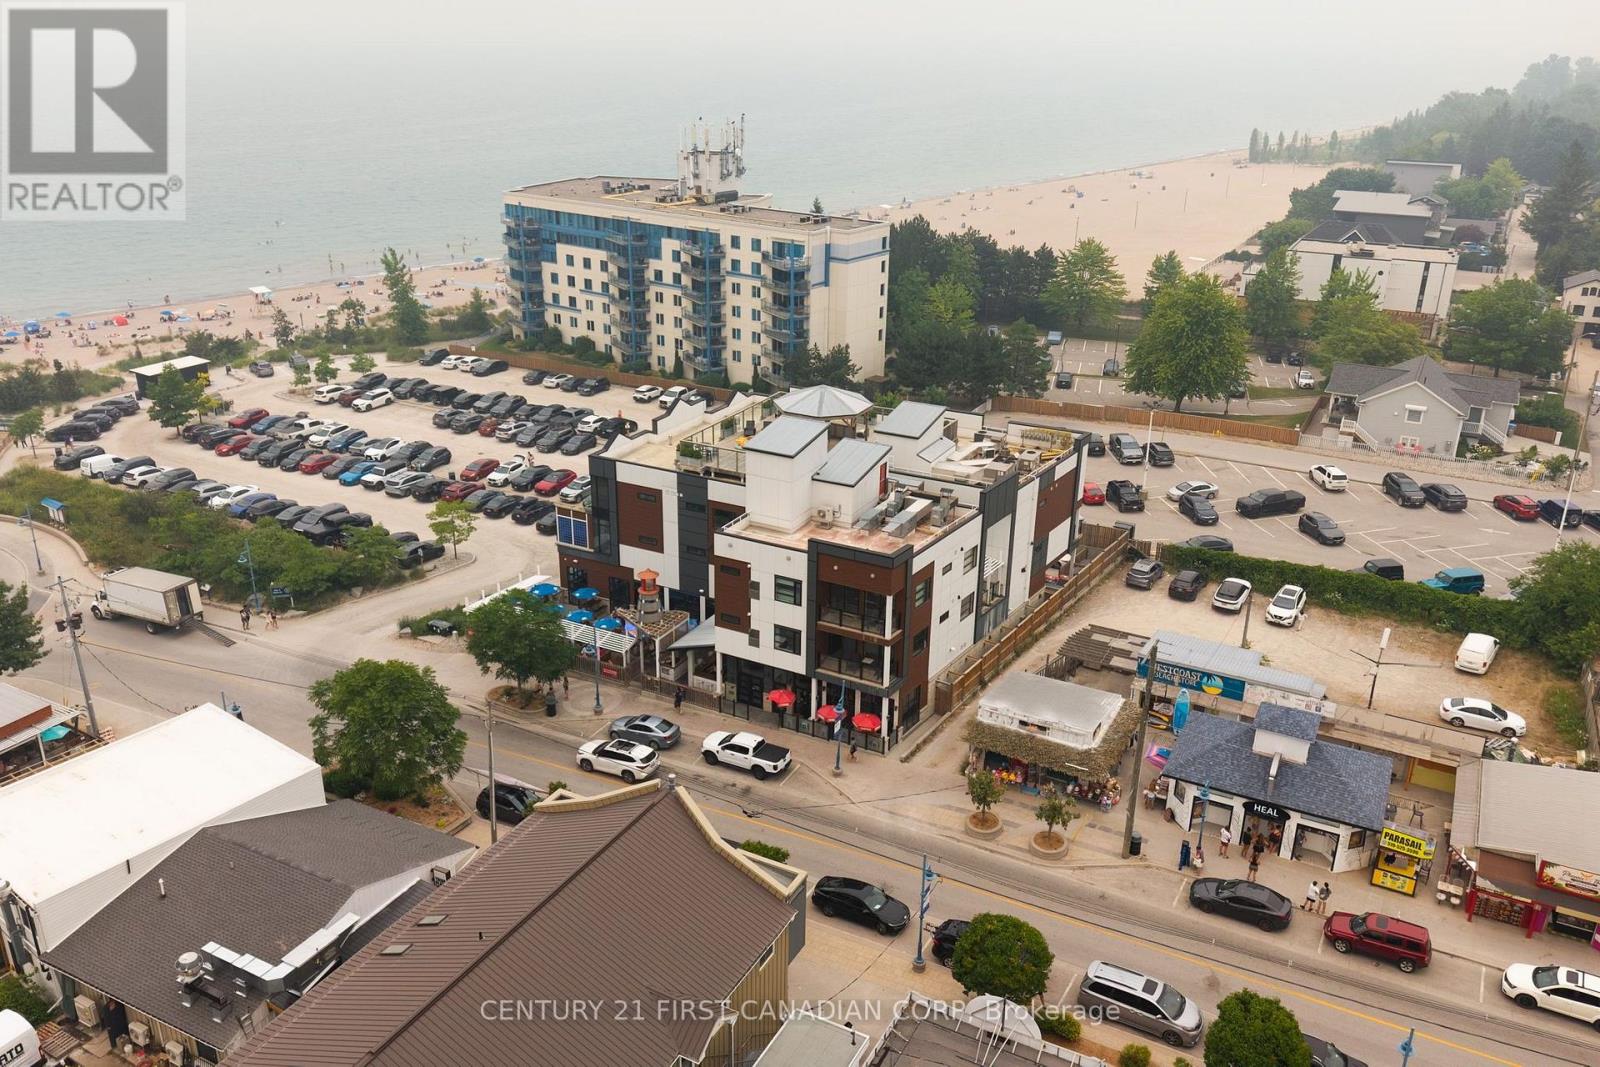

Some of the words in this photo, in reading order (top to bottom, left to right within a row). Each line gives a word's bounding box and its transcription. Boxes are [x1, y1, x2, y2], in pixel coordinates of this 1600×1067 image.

[1154, 663, 1202, 681] ESTCOAST
[1254, 803, 1279, 817] HEAL
[1384, 832, 1422, 850] PARASAIL
